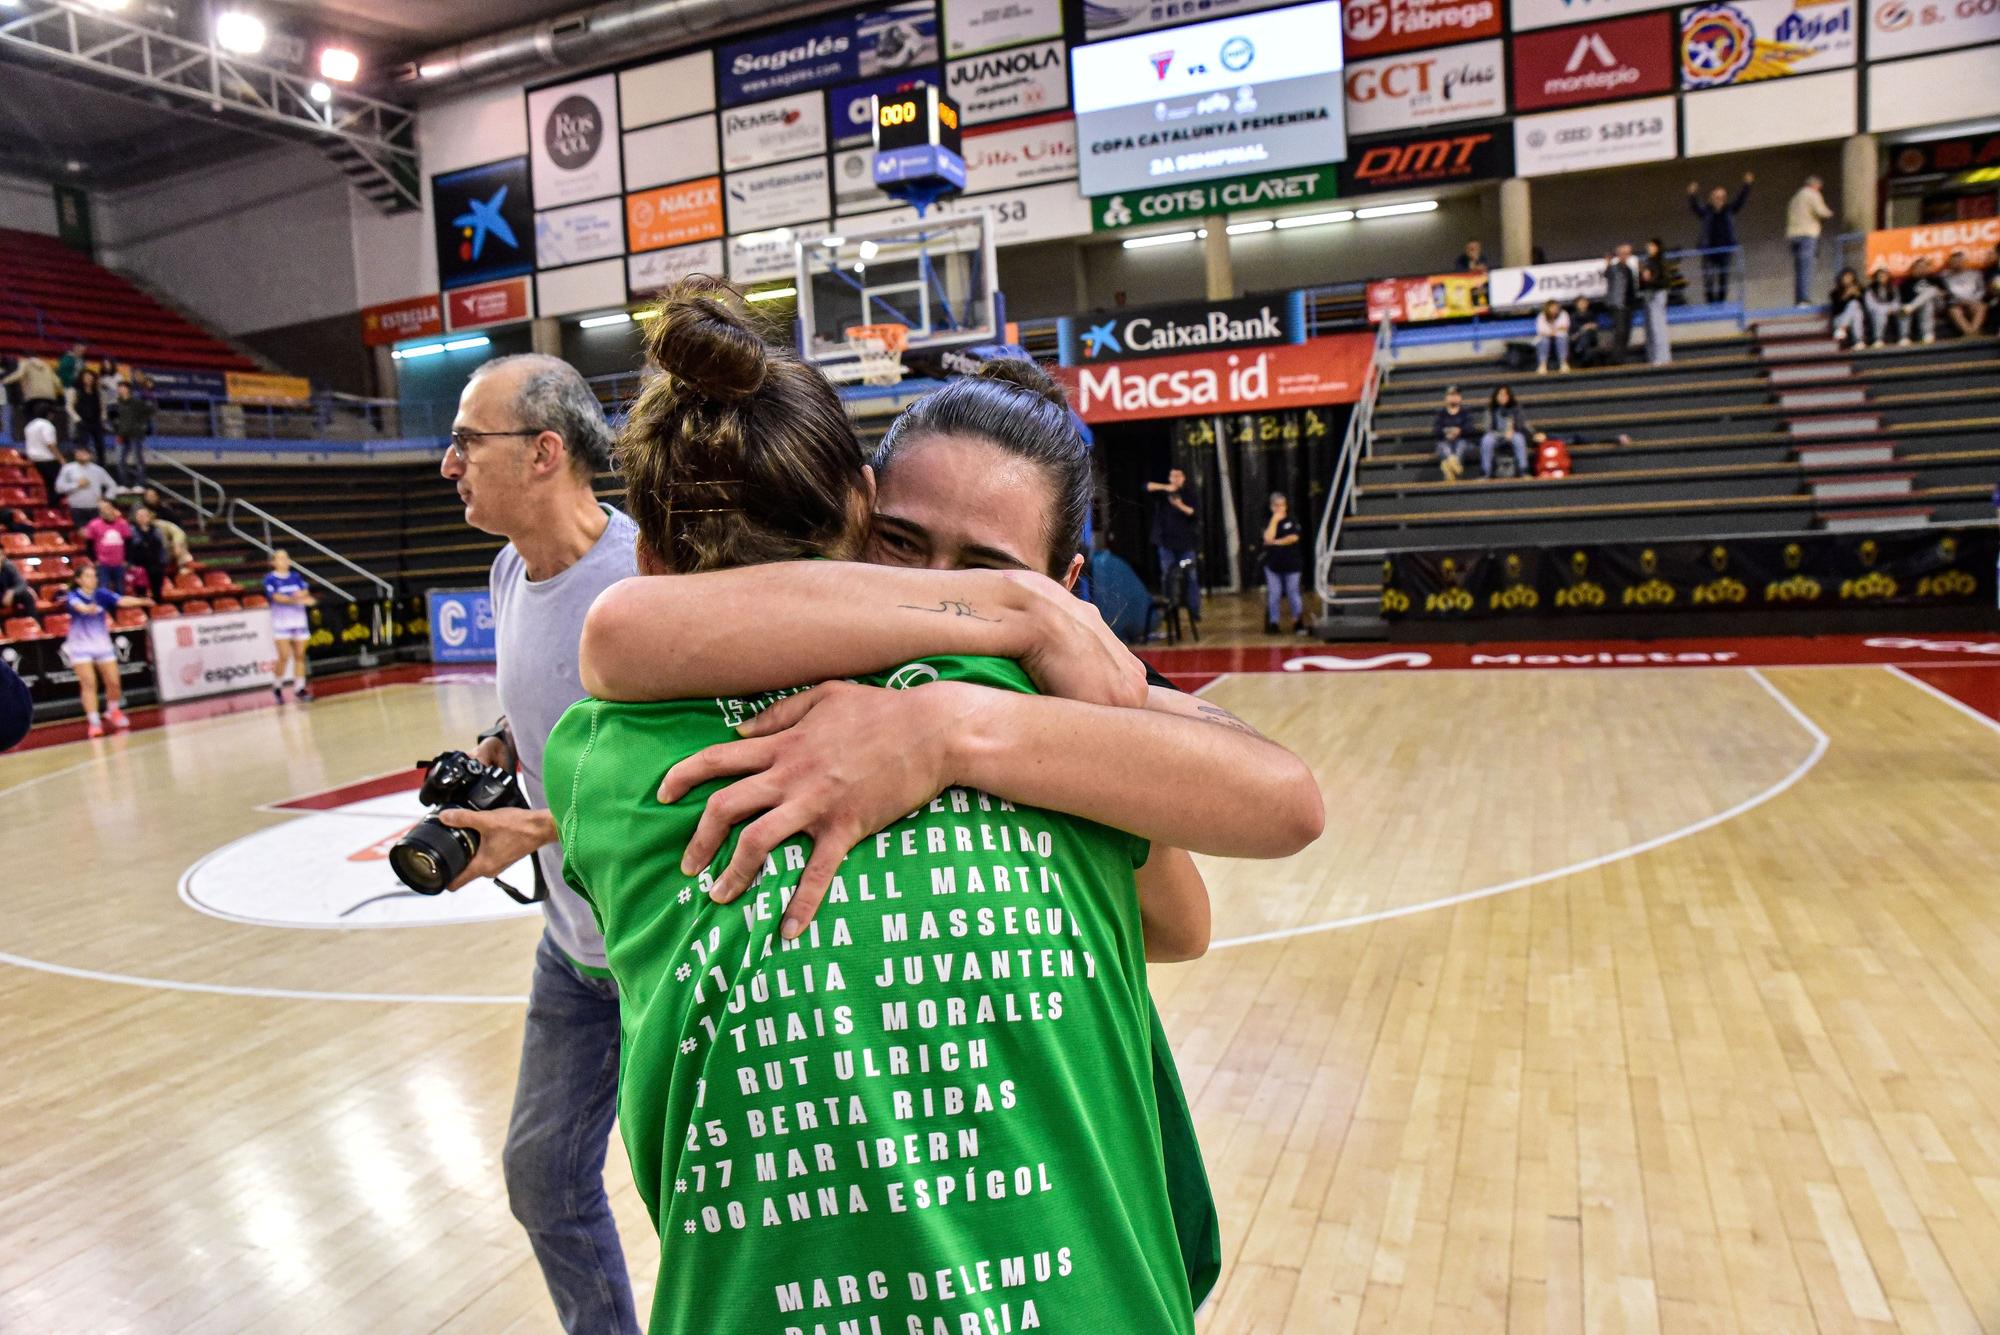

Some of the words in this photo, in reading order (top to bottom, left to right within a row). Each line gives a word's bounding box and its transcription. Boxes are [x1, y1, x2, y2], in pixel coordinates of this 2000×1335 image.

[732, 35, 849, 75] Sagalés
[951, 46, 1060, 86] JUANOLA
[1347, 58, 1437, 103] GCT
[555, 111, 596, 138] Ros
[1091, 136, 1135, 154] COPA
[1139, 118, 1237, 147] CATALUNYA
[1241, 106, 1330, 132] FEMENINA
[1600, 117, 1664, 141] sarsa
[1354, 132, 1493, 179] DMT
[659, 187, 718, 214] NACEX
[1139, 189, 1205, 217] COTS
[1221, 173, 1321, 206] CLARET
[1909, 220, 2000, 250] KIBUC
[1123, 306, 1282, 351] CaixaBank
[1077, 365, 1218, 414] Macsa
[1227, 352, 1269, 401] id
[876, 823, 1052, 860] FERREIRO
[727, 961, 848, 1014] JÚLIA
[875, 949, 1096, 988] JUVANTENY
[729, 1004, 855, 1054] THAIS
[881, 991, 1064, 1032] MORALES
[736, 1054, 809, 1096] RUT
[833, 1038, 989, 1081] ULRICH
[745, 1094, 868, 1140] BERTA
[892, 1079, 1017, 1121] RIBAS
[674, 1158, 733, 1194] #77
[755, 1143, 836, 1182] MAR
[856, 1128, 979, 1171] IBERN
[683, 1200, 747, 1235] #00
[762, 1184, 869, 1228] ANNA
[886, 1160, 1054, 1214] ESPÍGOL
[775, 1270, 890, 1313] MARC
[908, 1246, 1073, 1302] DELEMUS
